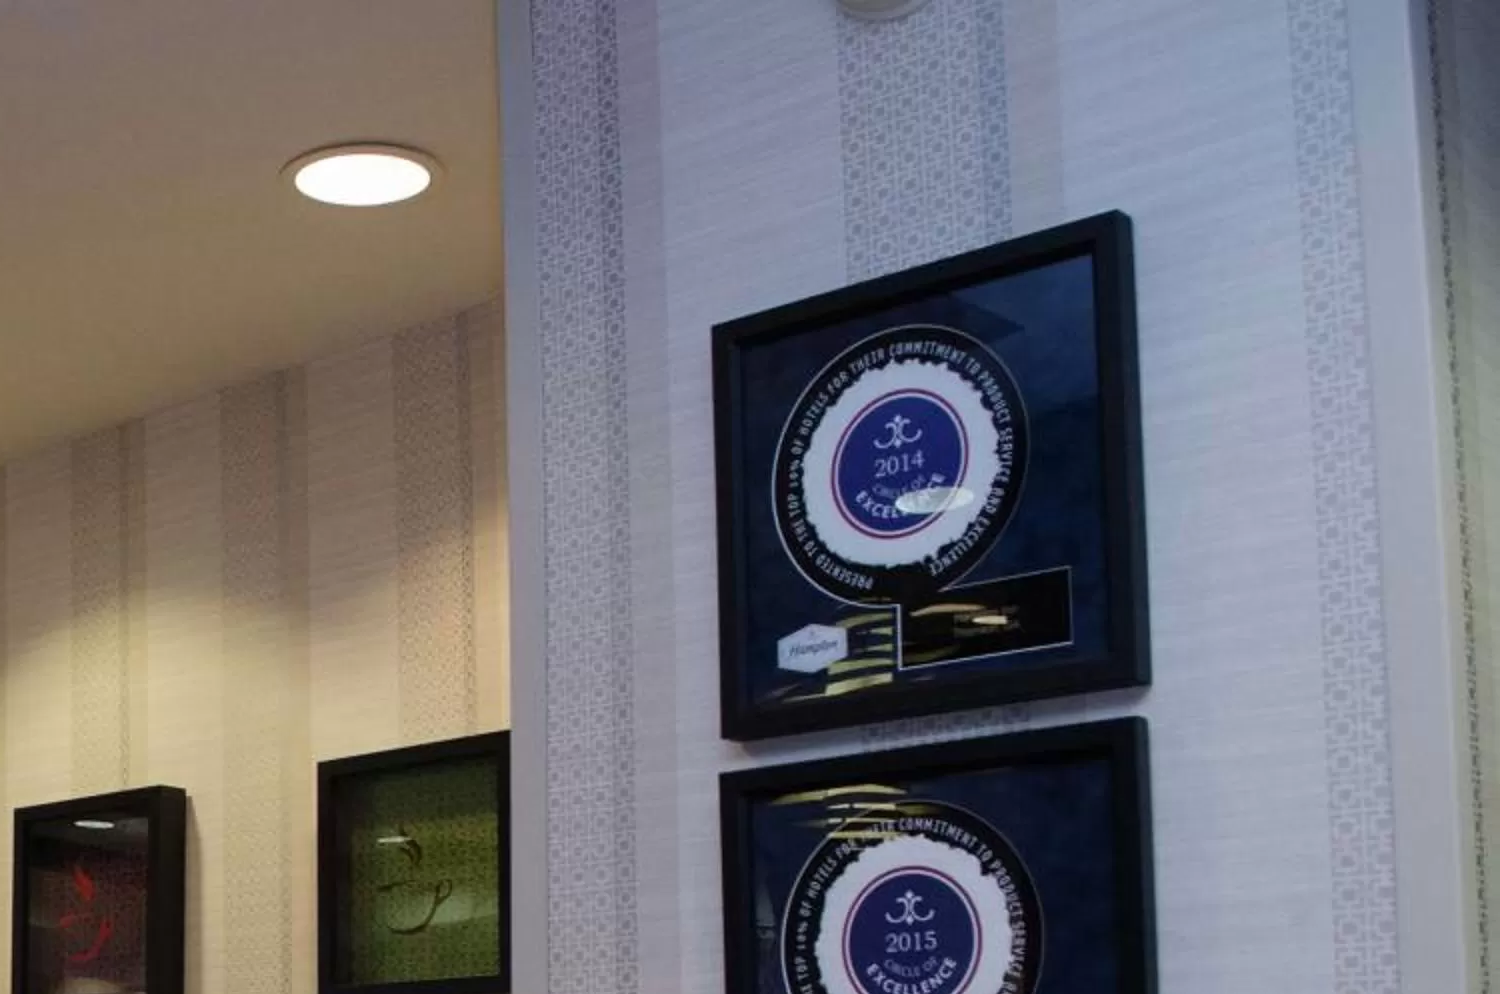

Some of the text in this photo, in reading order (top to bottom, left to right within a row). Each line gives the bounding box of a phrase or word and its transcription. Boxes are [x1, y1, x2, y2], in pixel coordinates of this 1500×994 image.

[849, 346, 886, 374] THEIR
[888, 340, 968, 363] COMMITMENT
[964, 354, 982, 374] TO
[827, 371, 850, 394] FOR
[799, 391, 829, 435] HOTELS
[873, 448, 926, 479] 2014
[993, 425, 1014, 483] SERVICE
[786, 493, 801, 519] TOP
[789, 518, 810, 543] THE
[803, 539, 818, 558] TO
[928, 514, 992, 578] EXCELLENCE
[794, 956, 810, 982] TOP
[806, 857, 838, 898] HOTELS
[898, 816, 979, 848] COMMITMENT
[976, 842, 994, 863] TO
[988, 858, 1024, 919] PRODUCT
[1010, 921, 1027, 979] SERVICE
[884, 928, 938, 954] 2015
